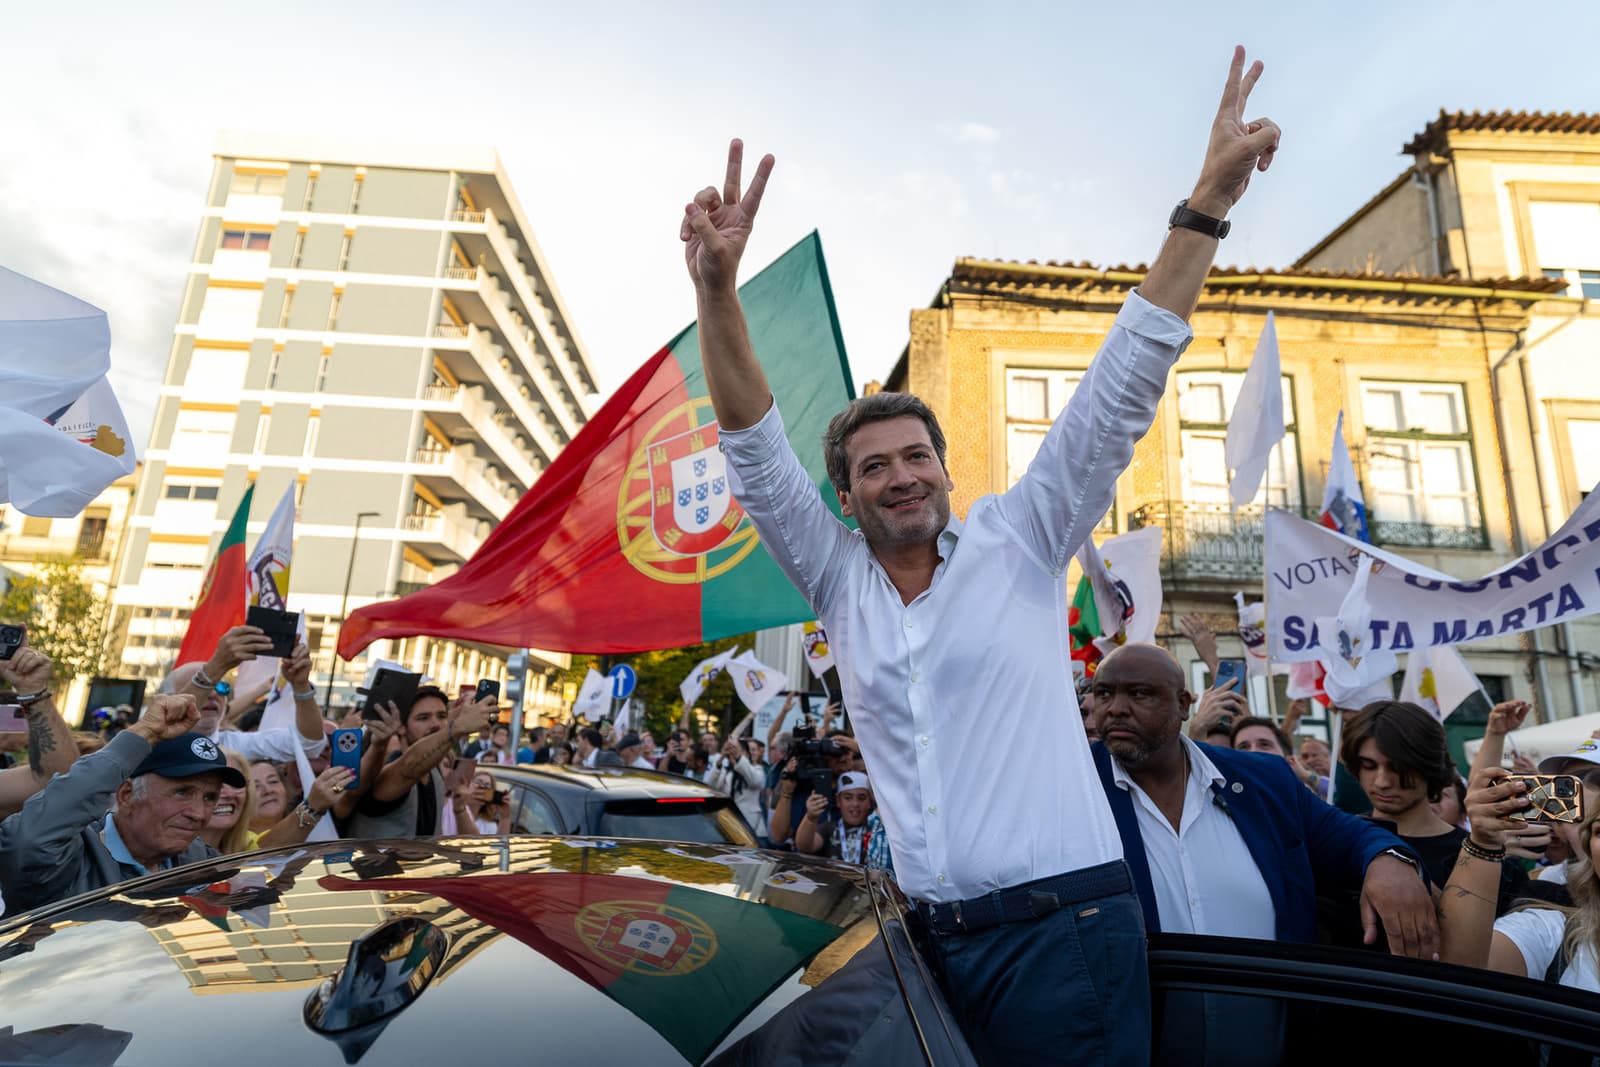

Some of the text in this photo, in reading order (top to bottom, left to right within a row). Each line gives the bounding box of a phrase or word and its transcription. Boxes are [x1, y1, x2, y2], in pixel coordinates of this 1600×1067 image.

[1273, 556, 1351, 590] VOTA
[1283, 615, 1414, 651] SATA
[1430, 583, 1587, 646] MARTA
